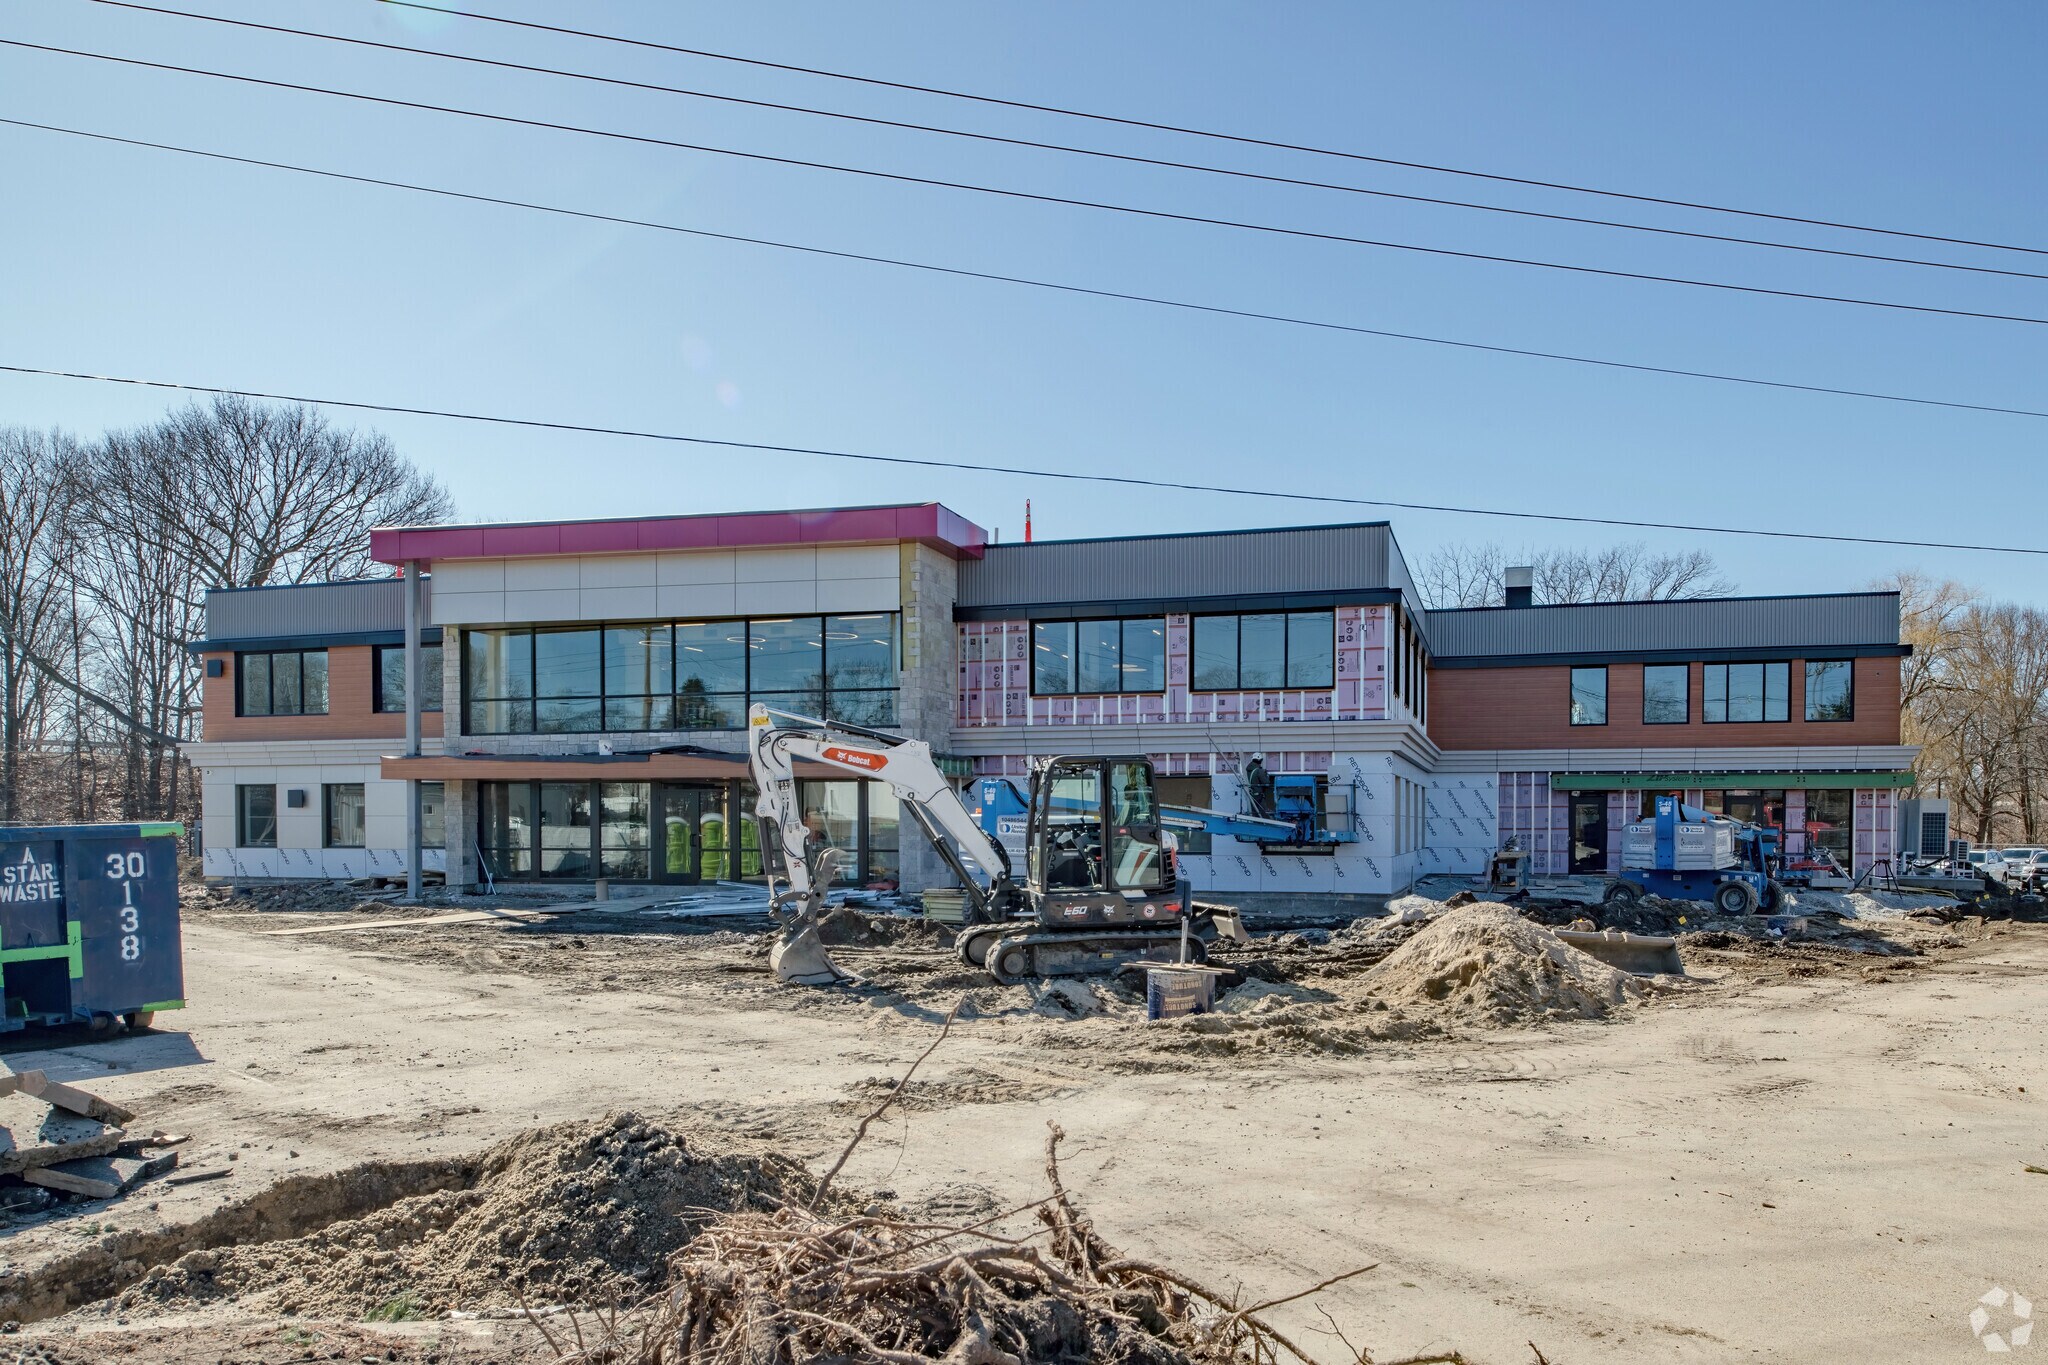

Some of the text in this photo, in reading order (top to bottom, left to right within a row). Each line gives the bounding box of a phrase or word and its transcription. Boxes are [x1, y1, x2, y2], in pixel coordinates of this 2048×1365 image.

[848, 755, 871, 766] Bobcat
[22, 847, 35, 864] A
[4, 863, 54, 884] STAR
[106, 852, 145, 879] 30
[0, 881, 62, 903] WASTE
[1063, 904, 1088, 916] E60
